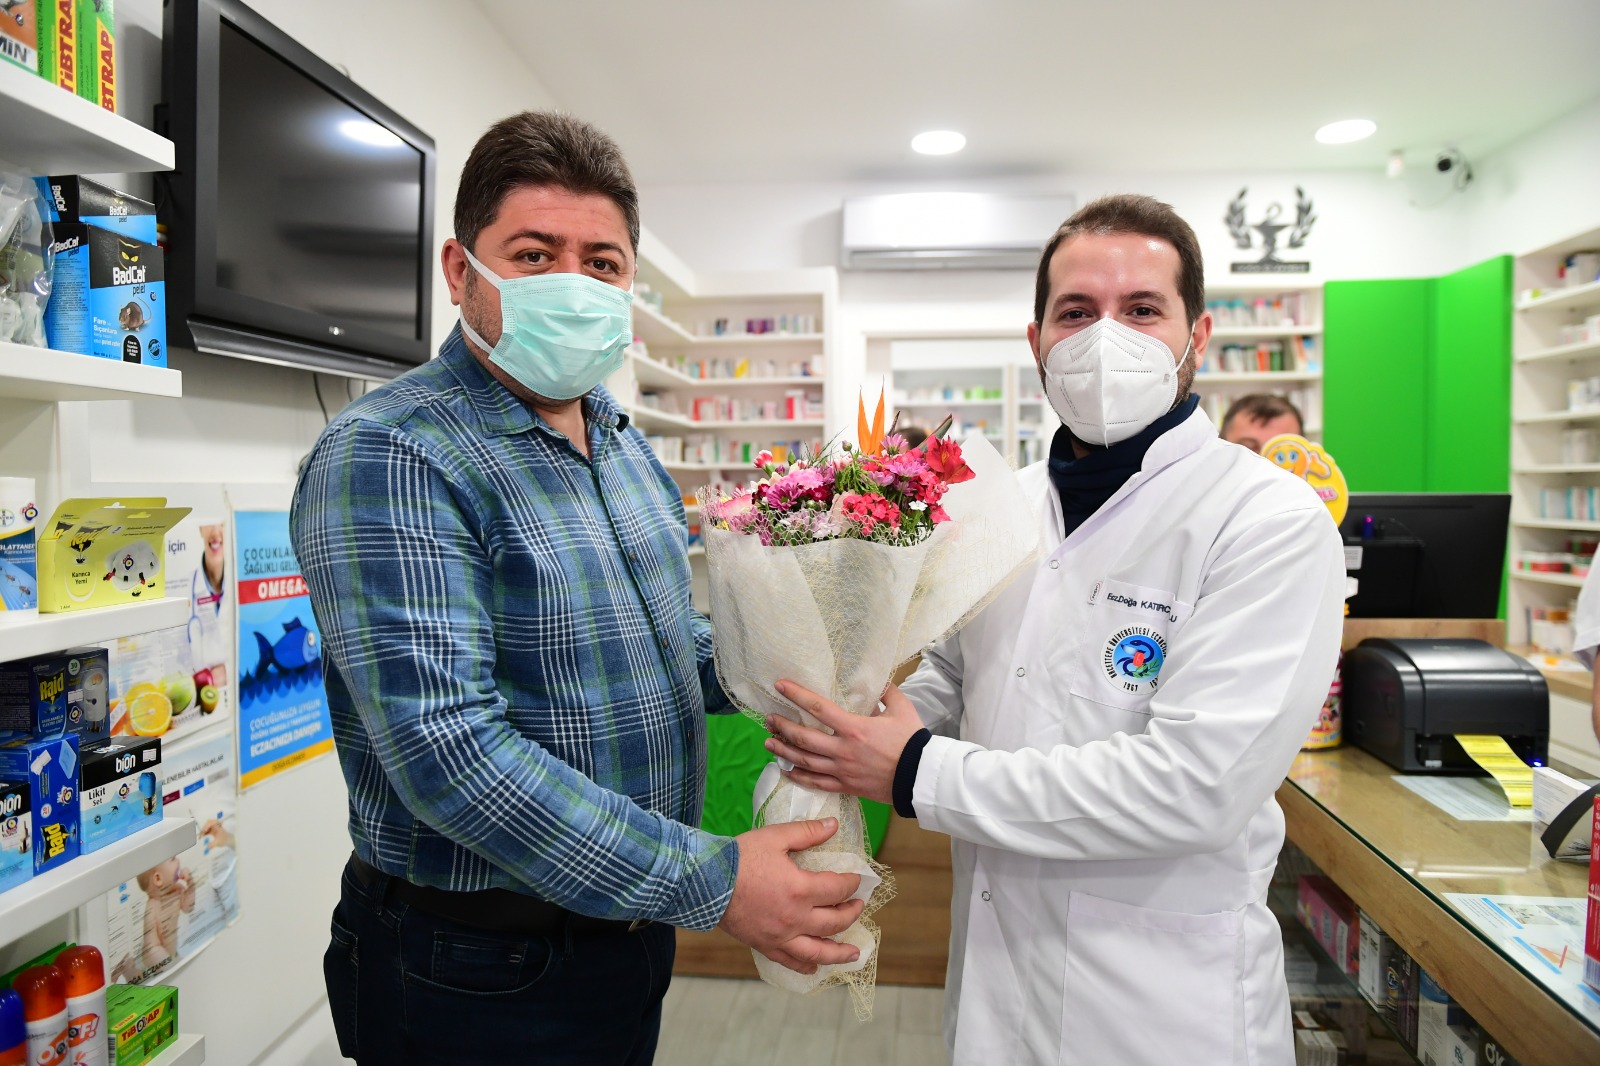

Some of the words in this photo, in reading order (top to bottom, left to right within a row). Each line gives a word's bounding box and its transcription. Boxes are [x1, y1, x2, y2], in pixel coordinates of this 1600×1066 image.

[113, 265, 147, 285] BadCat
[168, 540, 186, 554] için
[40, 672, 65, 702] Raid
[116, 754, 136, 774] bion
[88, 787, 106, 800] Likit
[45, 822, 65, 858] Raid
